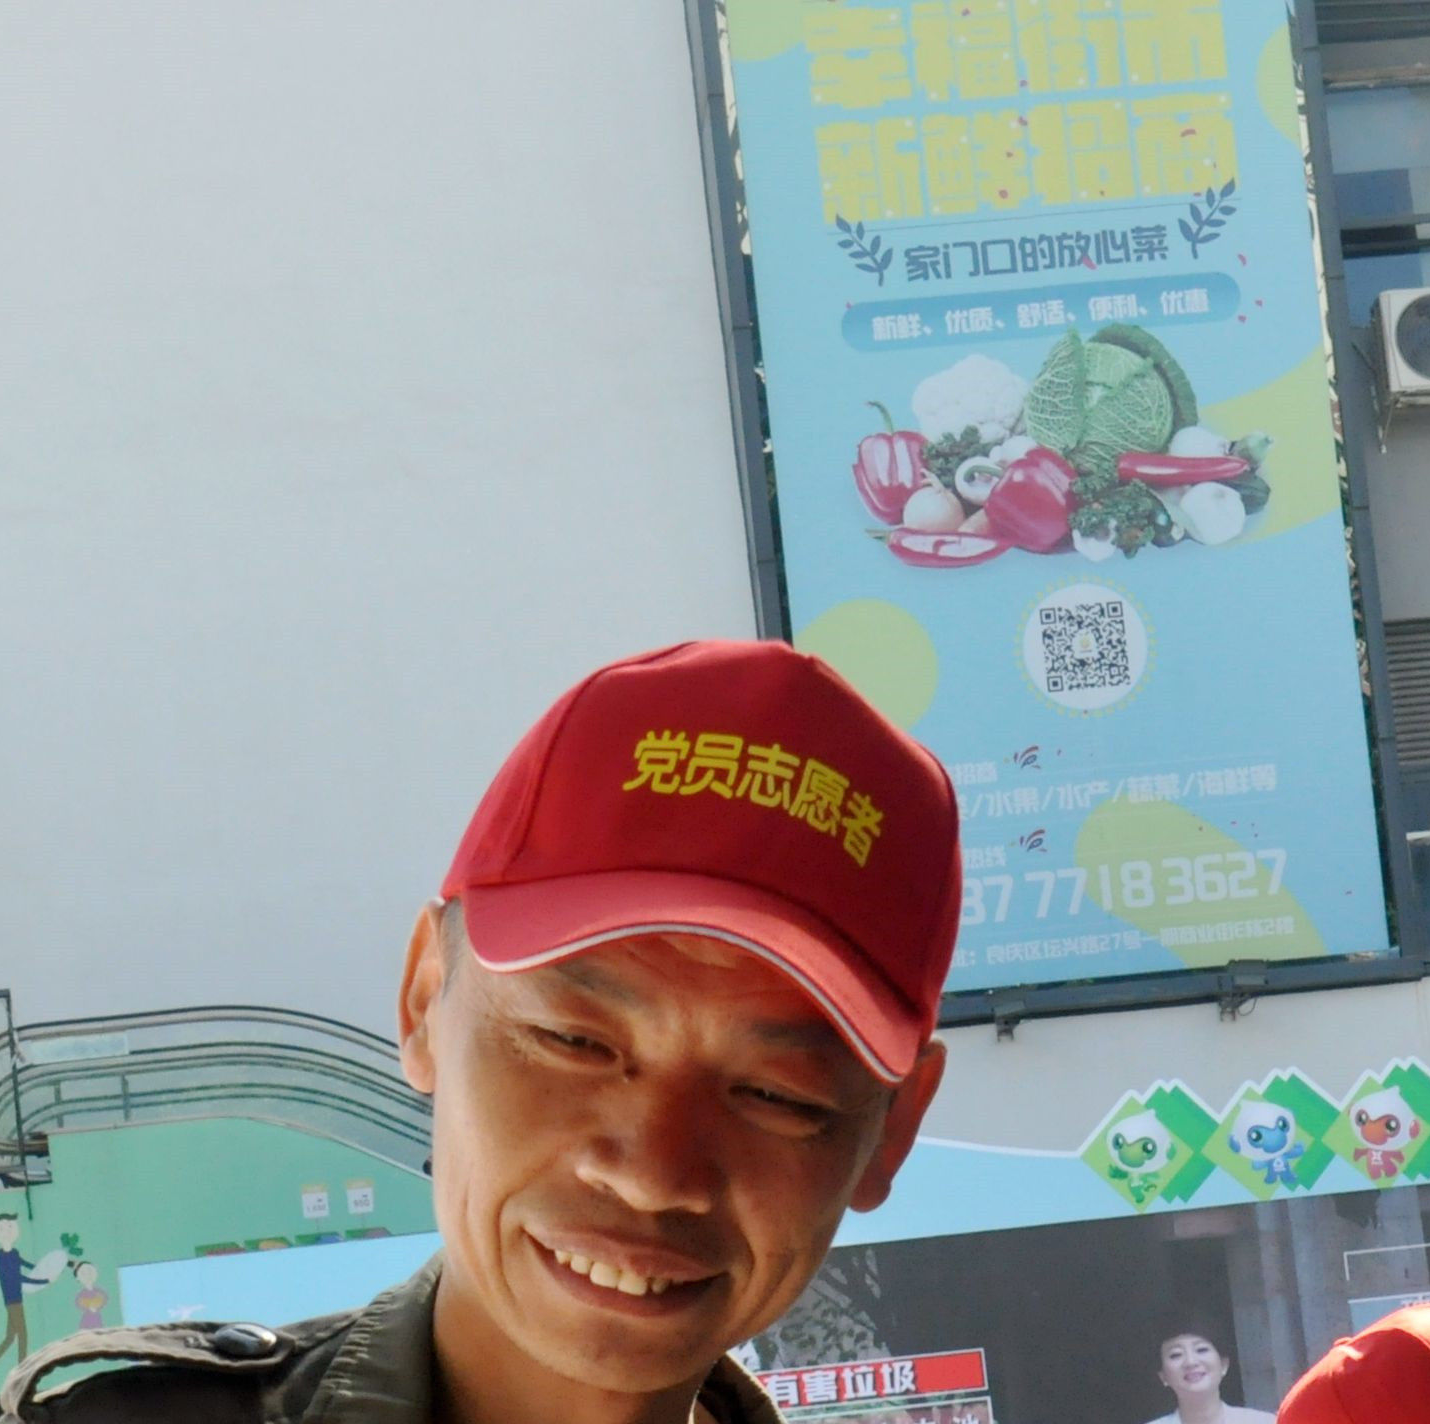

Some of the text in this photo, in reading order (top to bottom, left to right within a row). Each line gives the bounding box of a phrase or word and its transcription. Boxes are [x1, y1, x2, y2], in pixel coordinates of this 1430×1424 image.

[815, 92, 1241, 225] 新鲜招商
[904, 225, 1169, 282] 家门口的放心菜
[622, 729, 884, 868] 党员志愿者
[765, 1360, 917, 1406] 有害垃圾
